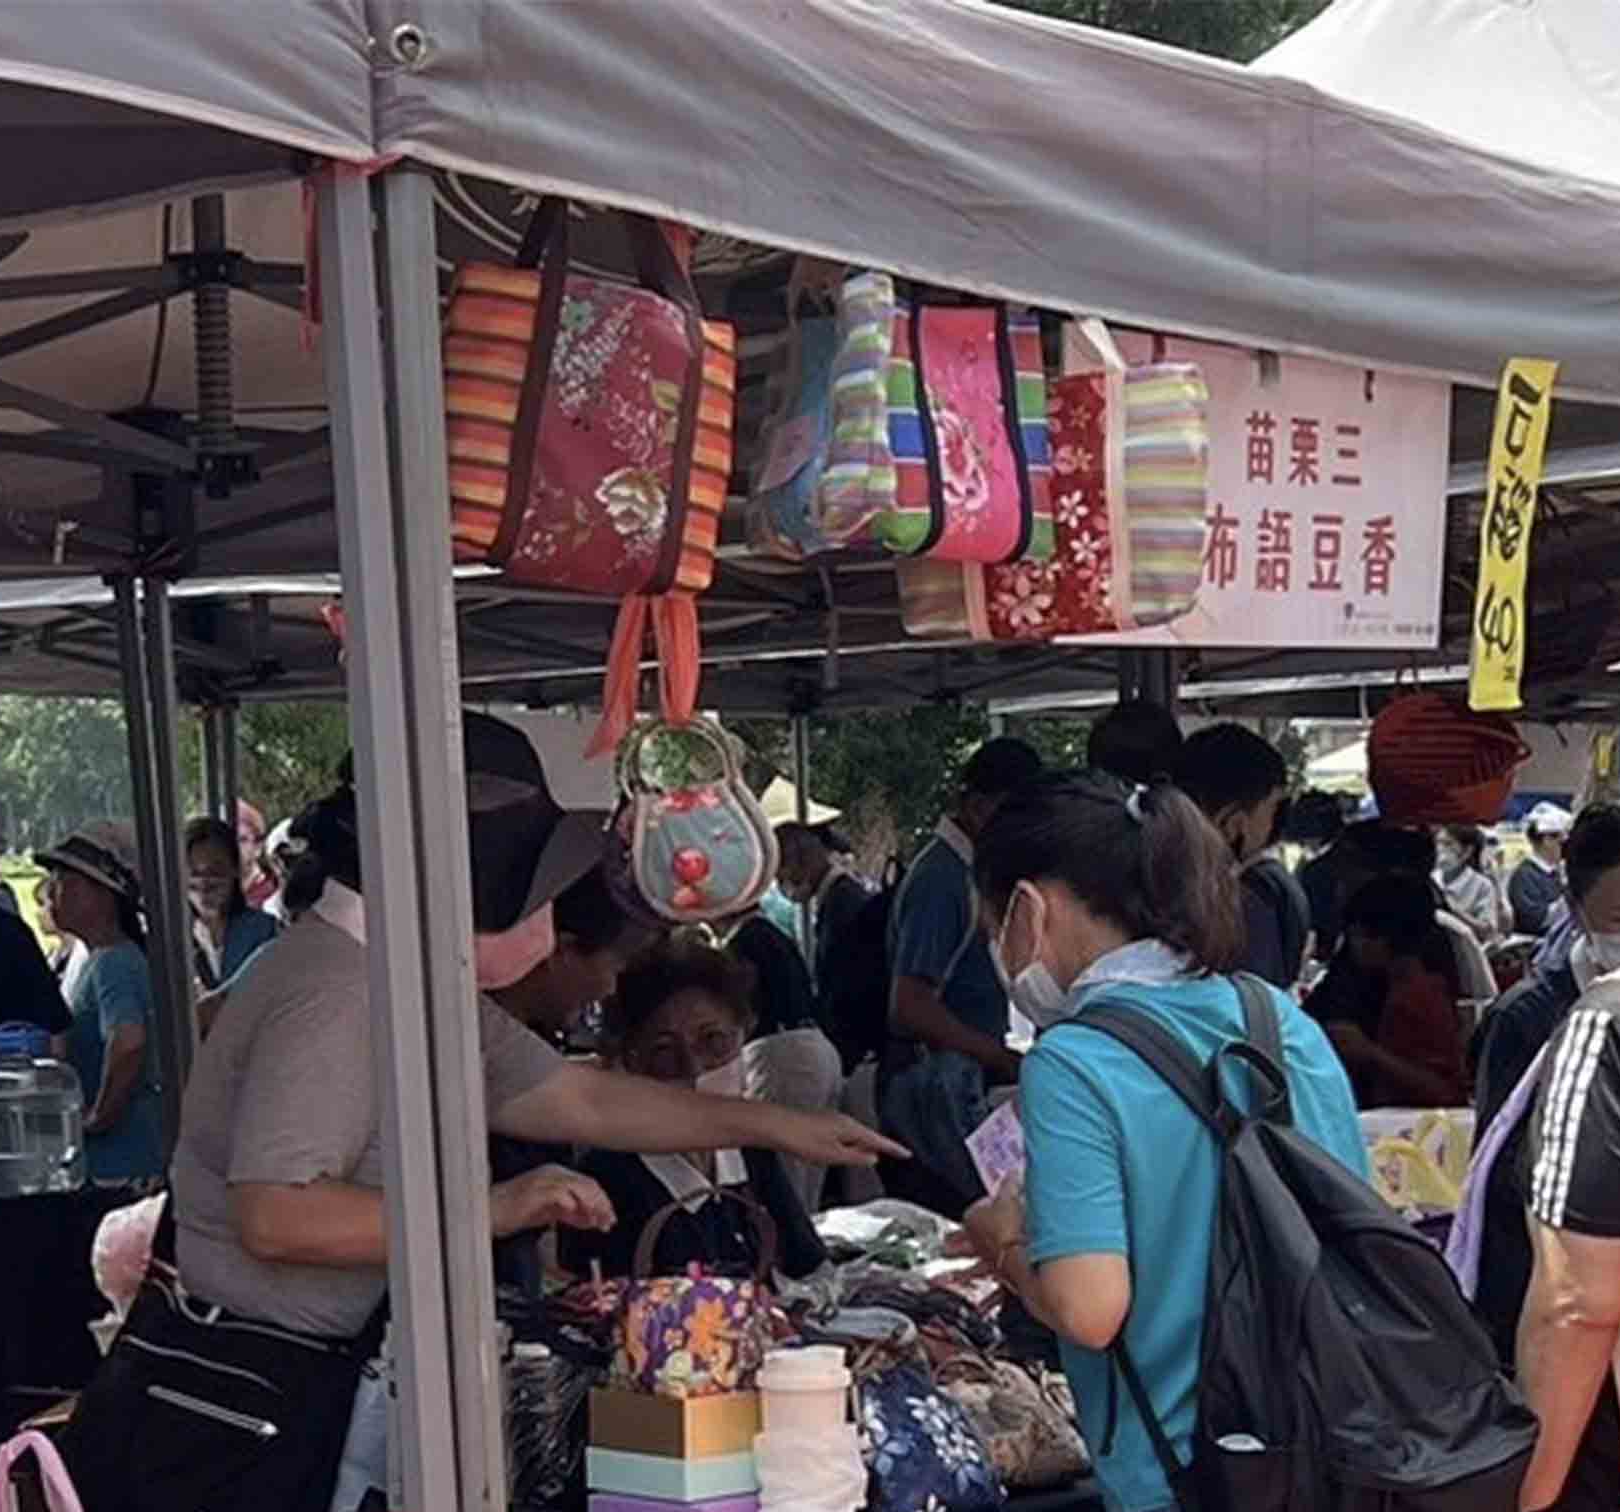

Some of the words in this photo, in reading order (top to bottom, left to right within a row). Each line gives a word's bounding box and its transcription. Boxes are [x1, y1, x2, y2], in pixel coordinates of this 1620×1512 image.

[1245, 409, 1363, 486] 苗栗三
[1204, 502, 1396, 596] 布語豆香
